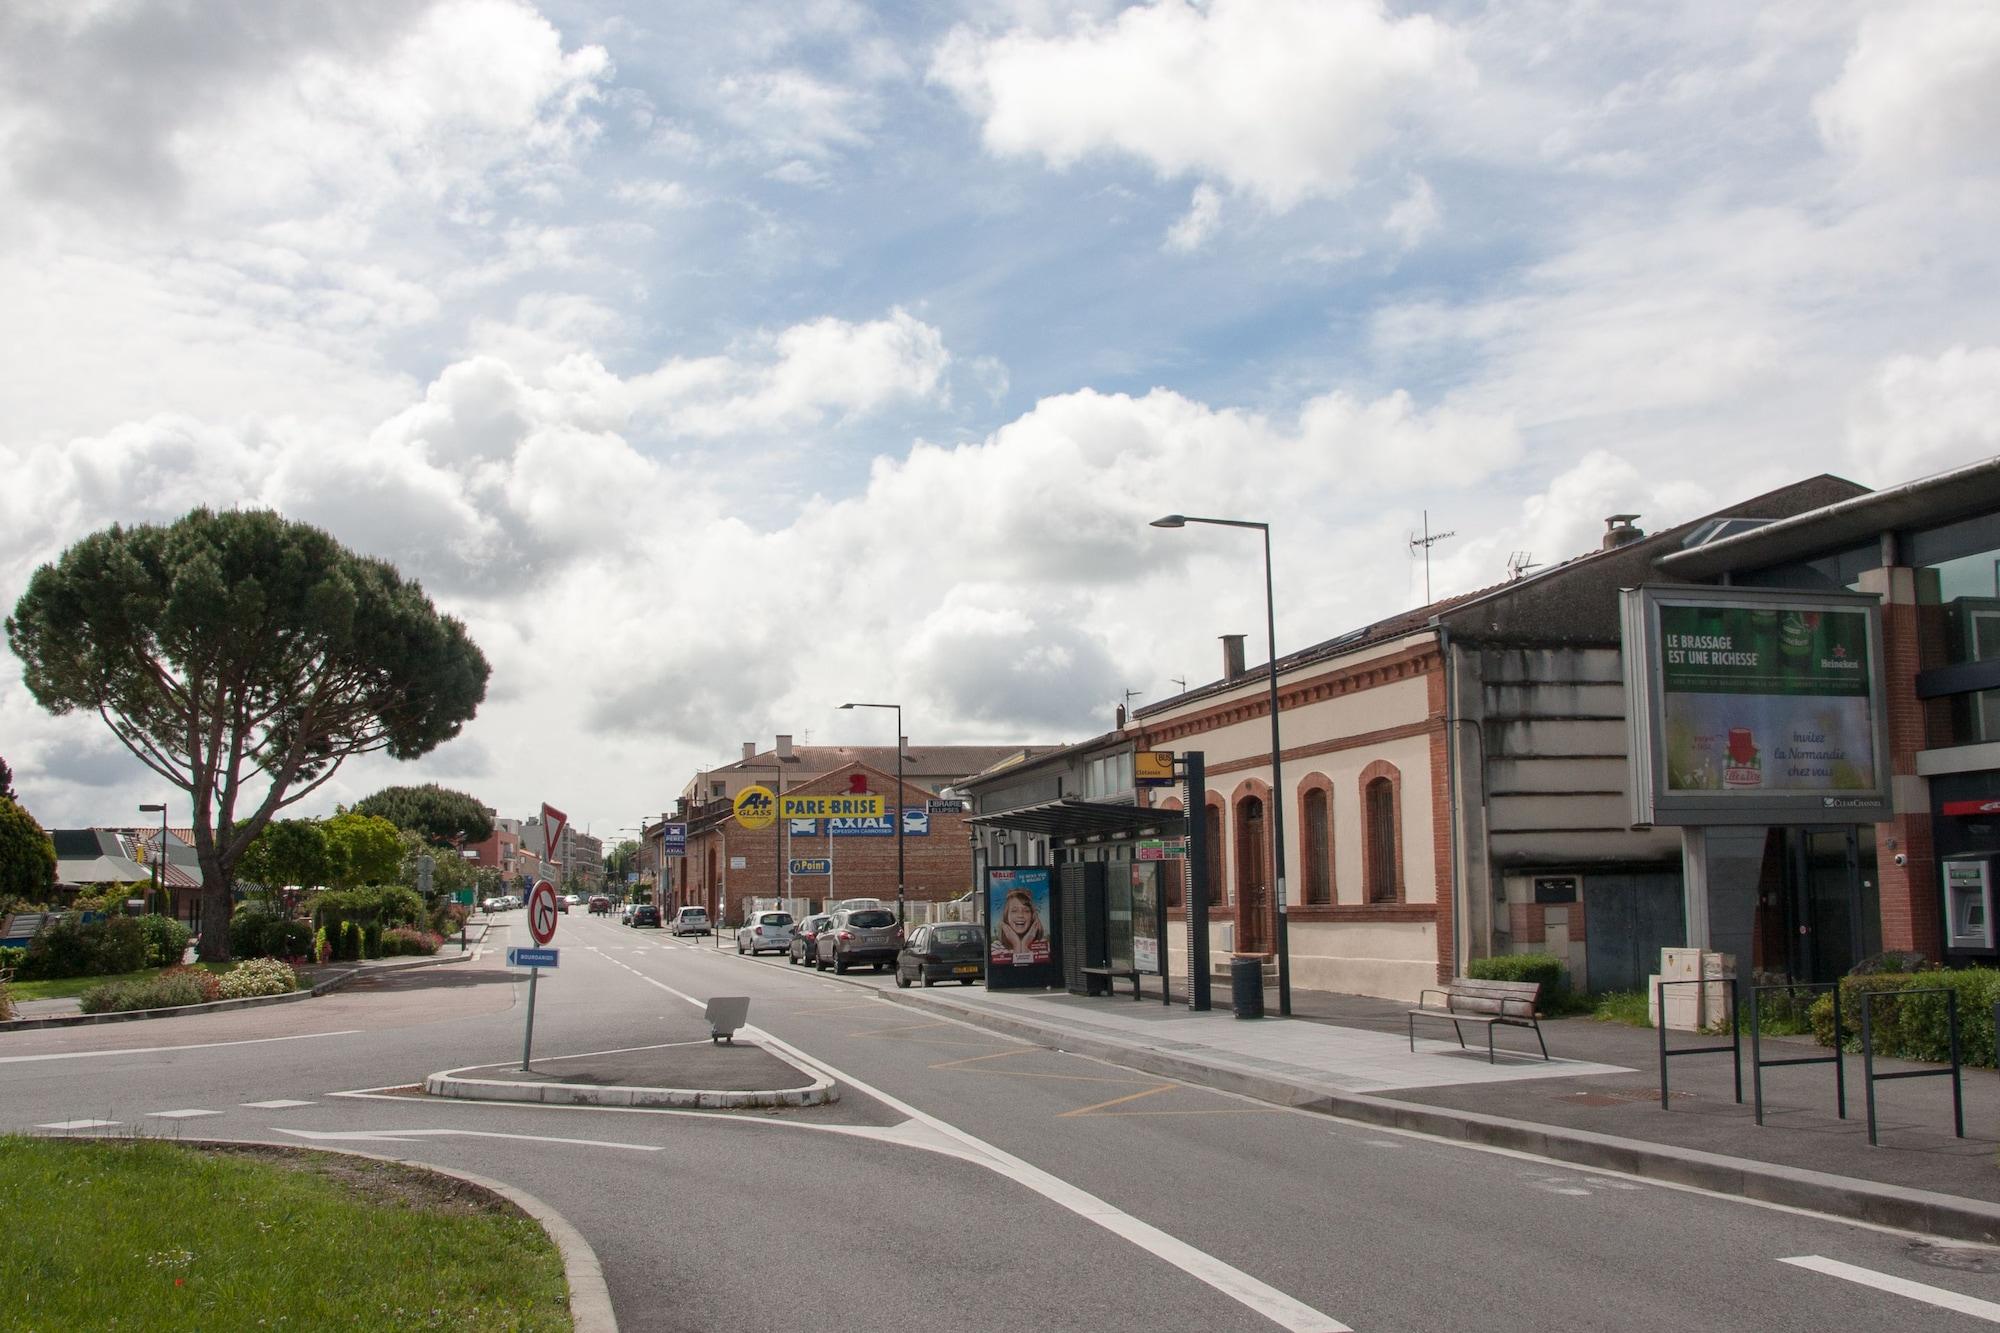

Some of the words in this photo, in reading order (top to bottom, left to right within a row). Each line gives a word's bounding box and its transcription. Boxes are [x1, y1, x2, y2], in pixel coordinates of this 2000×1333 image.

[1667, 634, 1678, 648] LE
[1681, 634, 1733, 650] BRASSAGE
[1668, 650, 1686, 664] EST
[1688, 651, 1709, 665] UNE
[1711, 652, 1758, 666] RICHESSE
[1821, 658, 1859, 669] Heineken
[1793, 731, 1825, 743] invitez
[1158, 753, 1172, 762] BUS
[1774, 747, 1786, 760] la
[1788, 744, 1847, 760] Normandie
[1787, 765, 1810, 777] chez
[737, 793, 772, 809] A+
[738, 809, 772, 817] GLASS
[828, 817, 892, 828] AXIAL
[801, 860, 825, 870] Point
